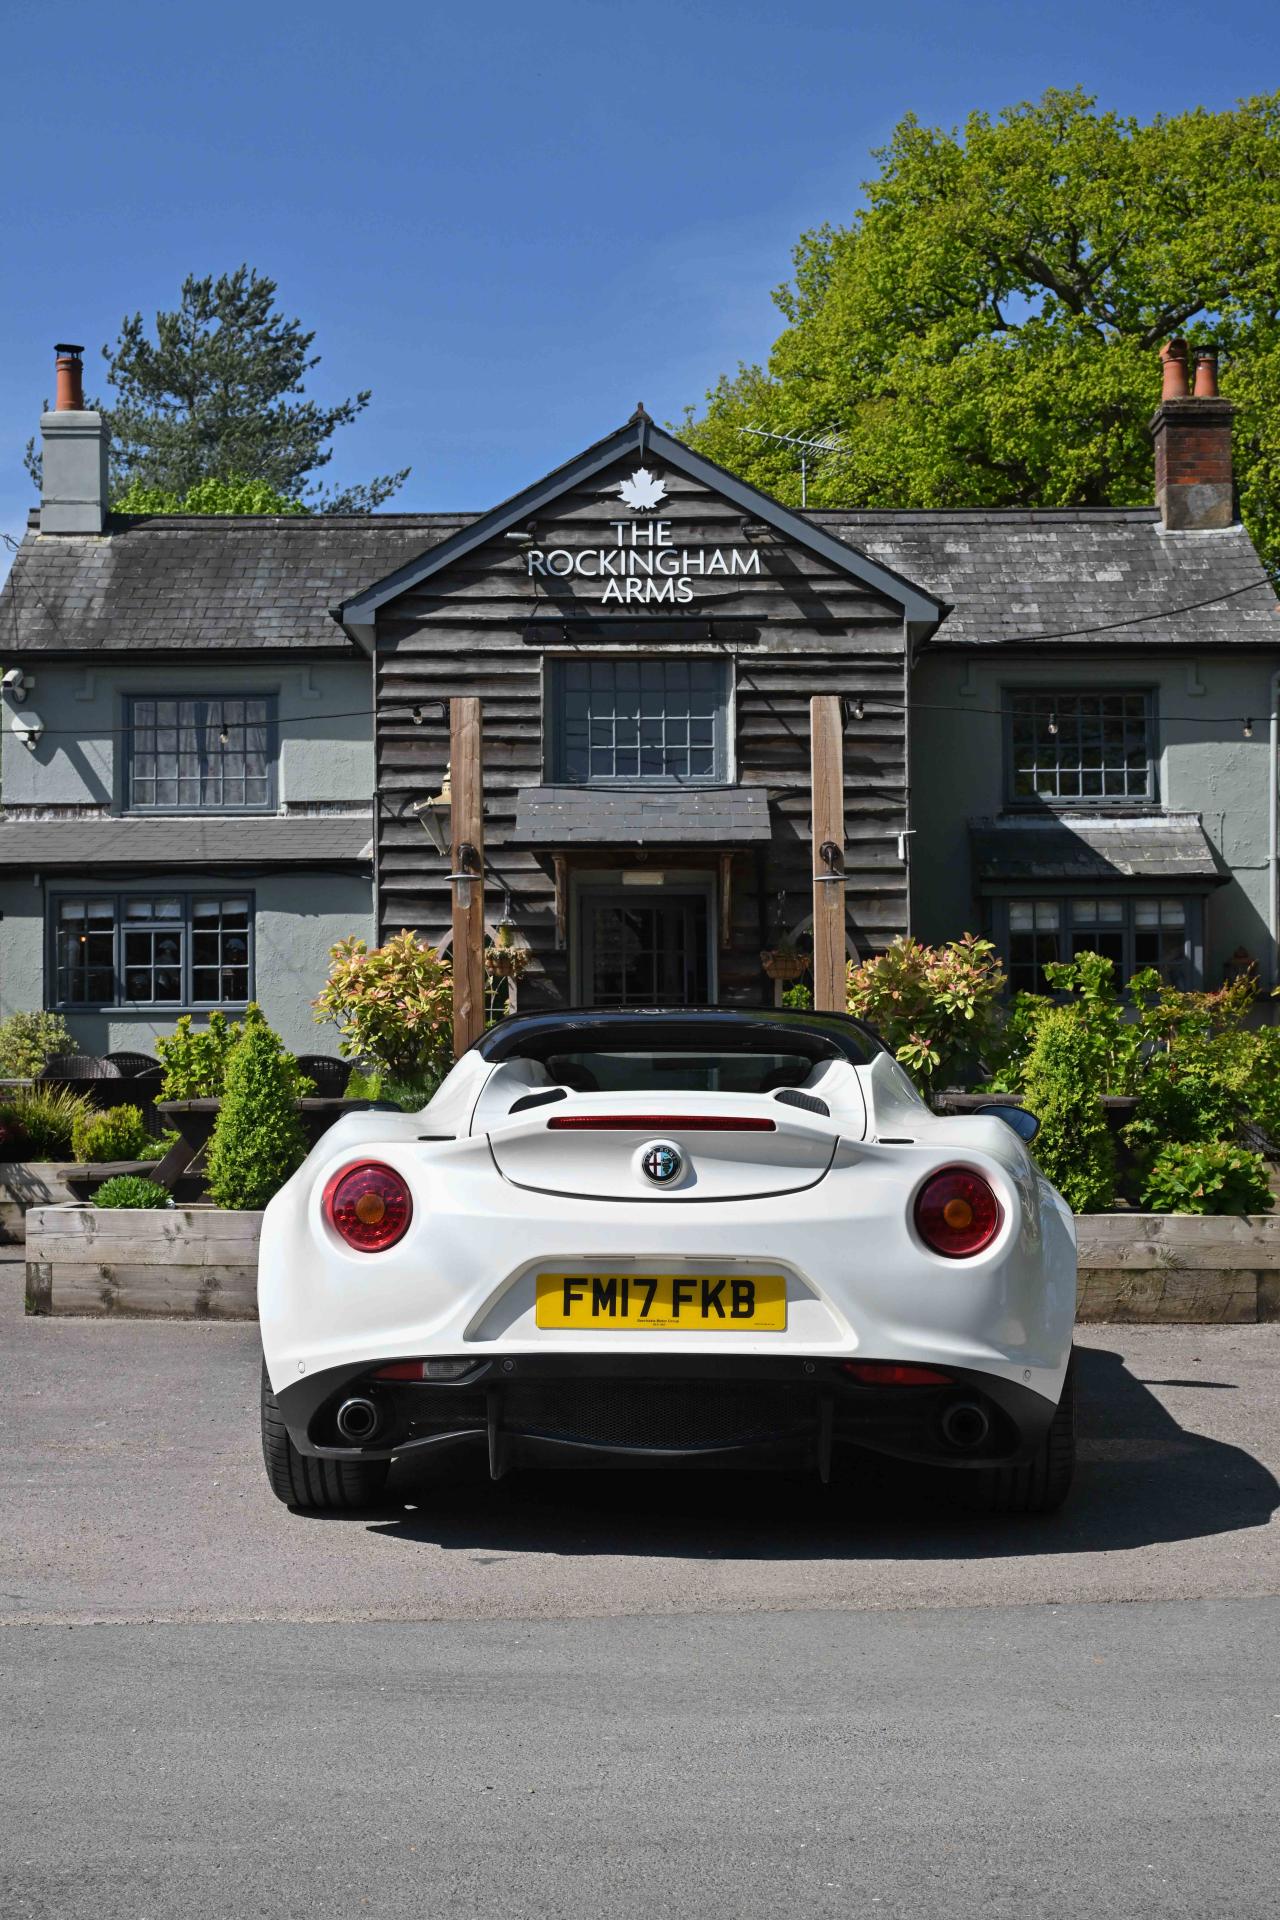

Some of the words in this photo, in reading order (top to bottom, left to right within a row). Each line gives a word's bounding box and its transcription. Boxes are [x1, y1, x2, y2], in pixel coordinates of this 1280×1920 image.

[610, 520, 674, 547] THE
[527, 548, 761, 577] ROCKINGHAM
[601, 577, 694, 604] ARMS
[562, 1277, 658, 1318] FM17
[672, 1278, 756, 1319] FKB
